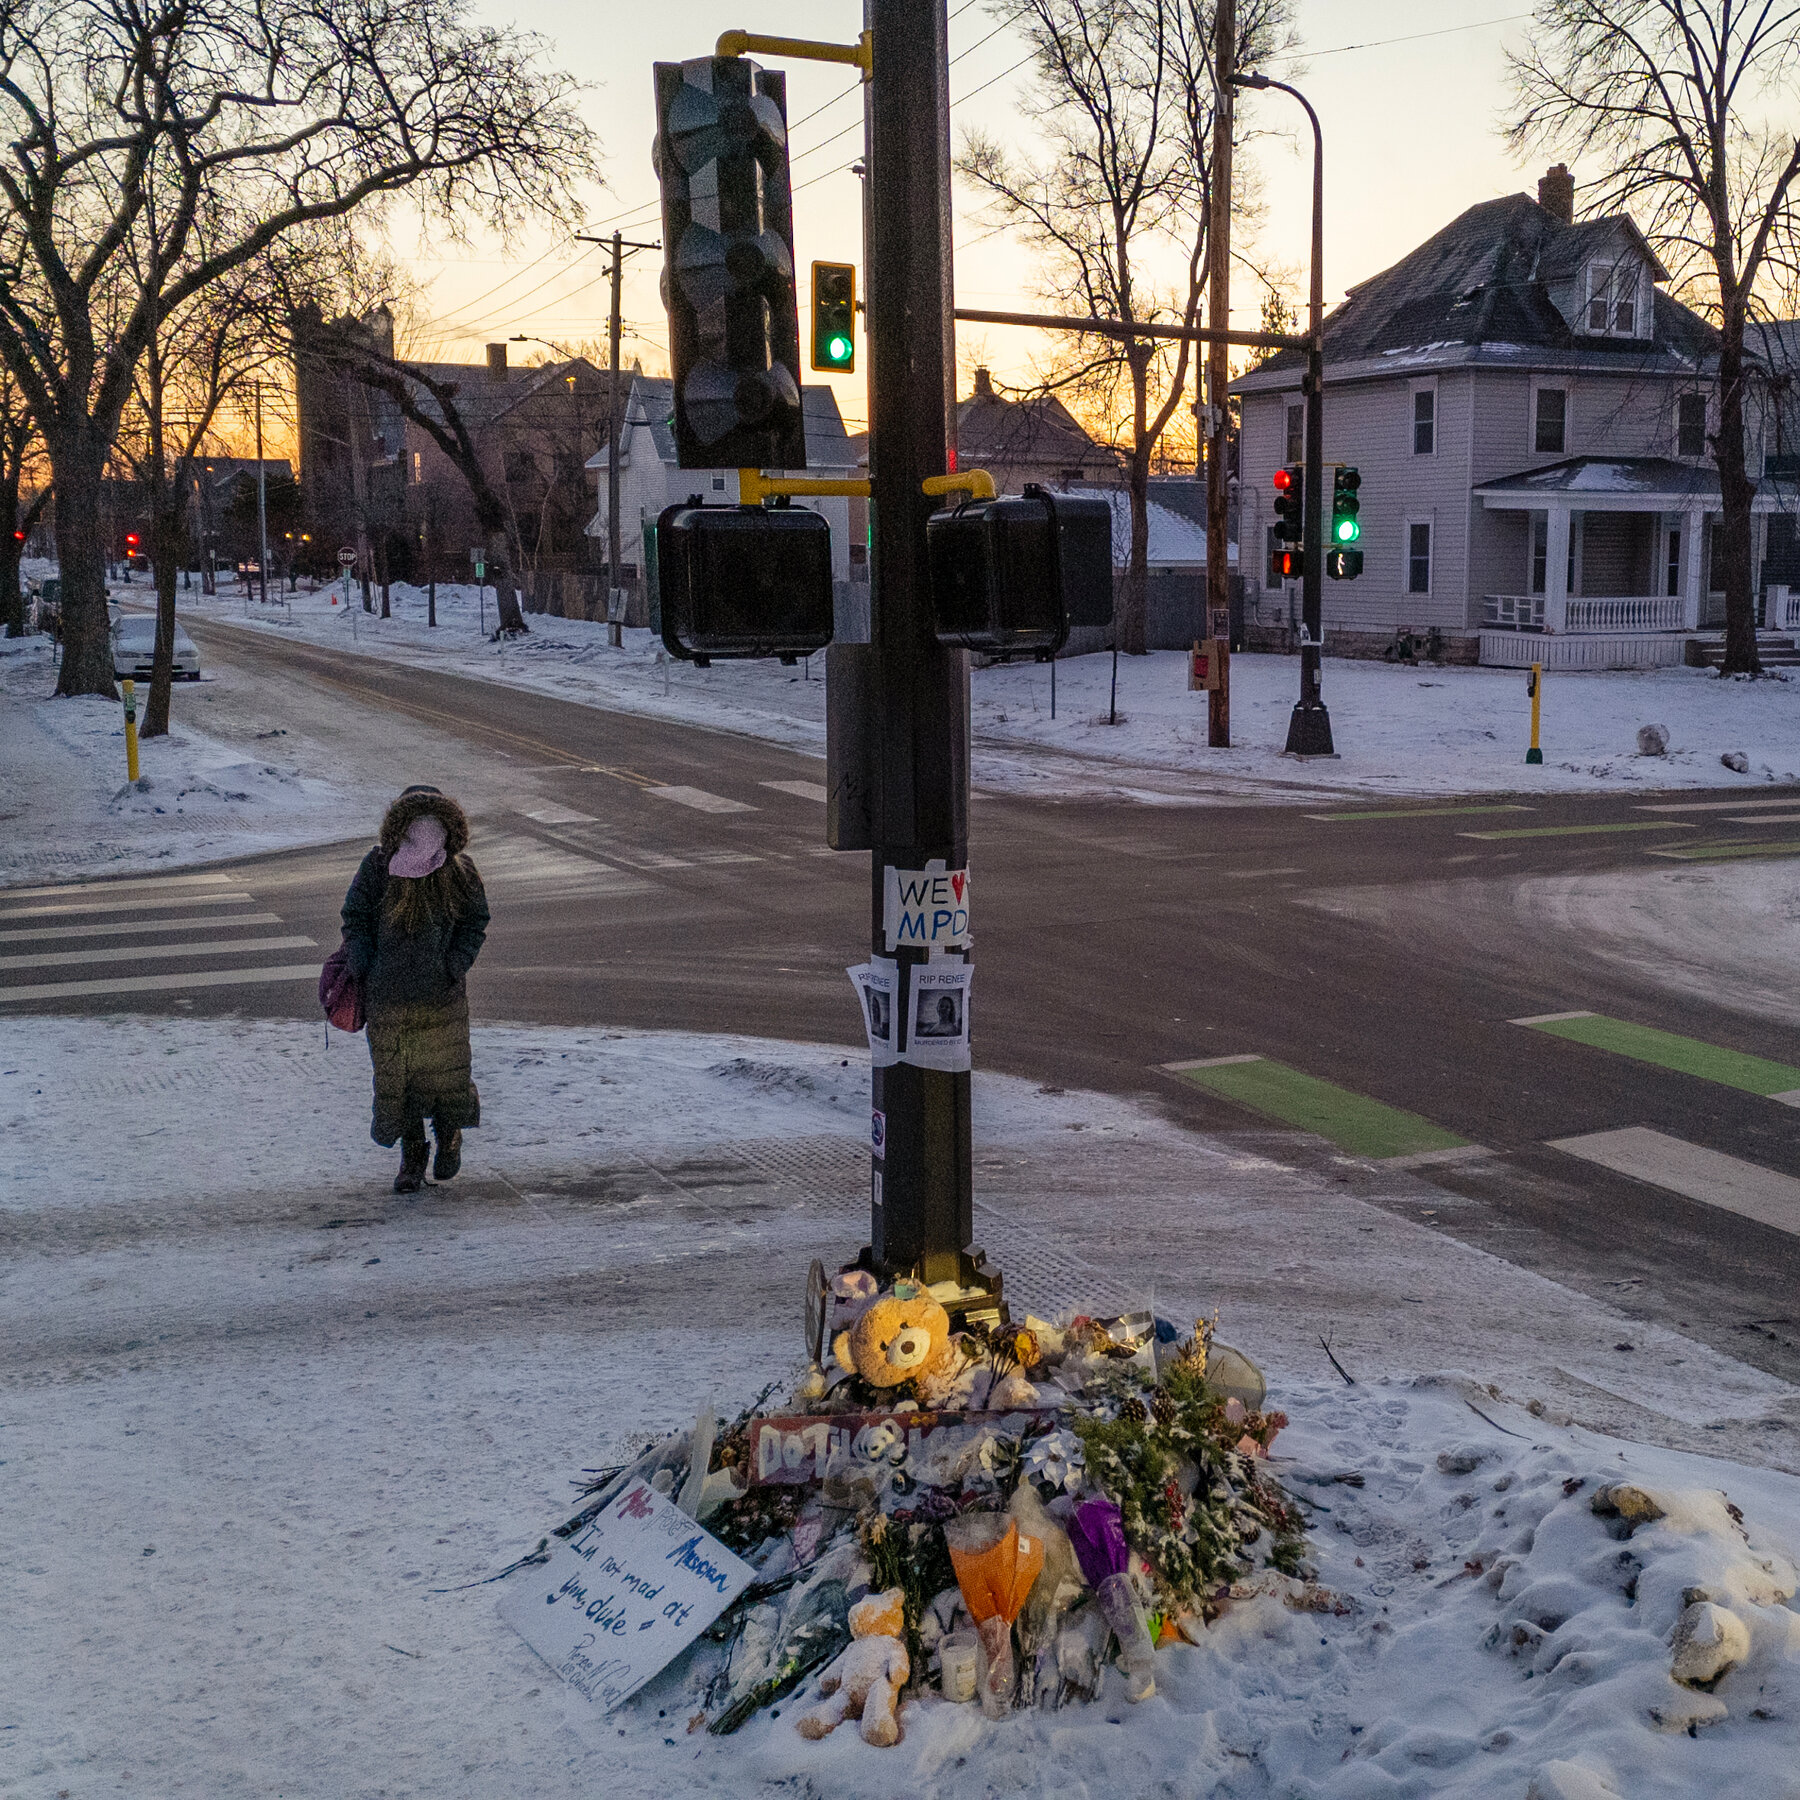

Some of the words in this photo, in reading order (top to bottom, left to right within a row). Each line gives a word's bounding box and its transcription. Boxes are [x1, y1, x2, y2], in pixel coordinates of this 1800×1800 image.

[898, 876, 948, 907] WE
[898, 909, 968, 940] MPD
[919, 974, 936, 985] RIP
[938, 973, 965, 985] RENEE
[665, 1535, 731, 1593] Musician
[600, 1556, 628, 1578] not
[620, 1573, 665, 1600] mad
[662, 1601, 694, 1627] at
